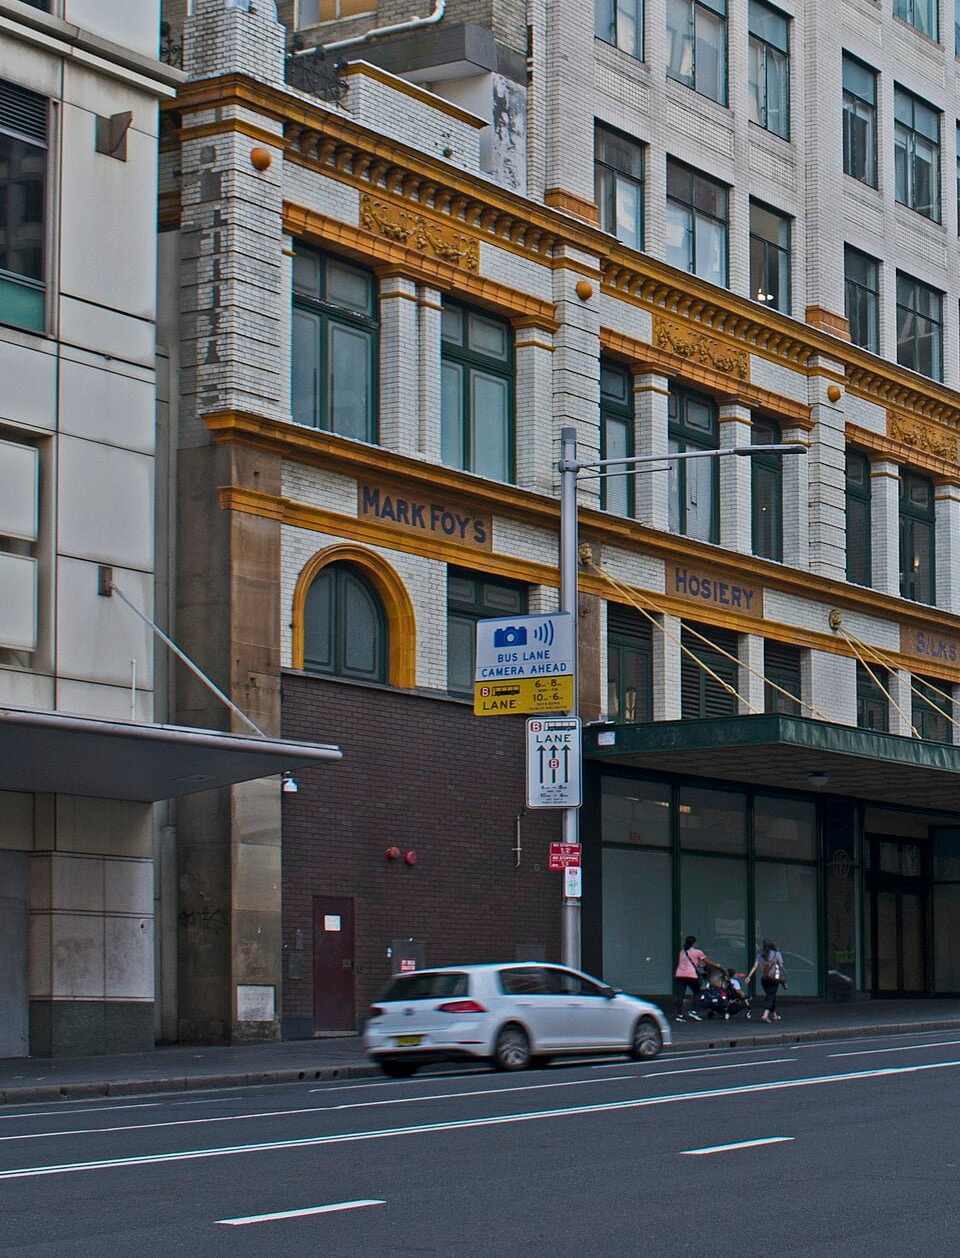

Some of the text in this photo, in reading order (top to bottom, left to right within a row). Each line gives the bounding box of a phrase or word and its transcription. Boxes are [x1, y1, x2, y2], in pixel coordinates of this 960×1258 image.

[363, 485, 487, 543] MARK FOY'S
[675, 567, 753, 609] HOSIERY
[917, 630, 957, 661] SILKS
[497, 650, 550, 663] BUS LANE
[481, 663, 567, 677] CAMERA AHEAD
[481, 687, 490, 697] B
[482, 699, 517, 710] LANE
[531, 722, 541, 732] B
[536, 734, 571, 743] LANE
[549, 759, 559, 769] B
